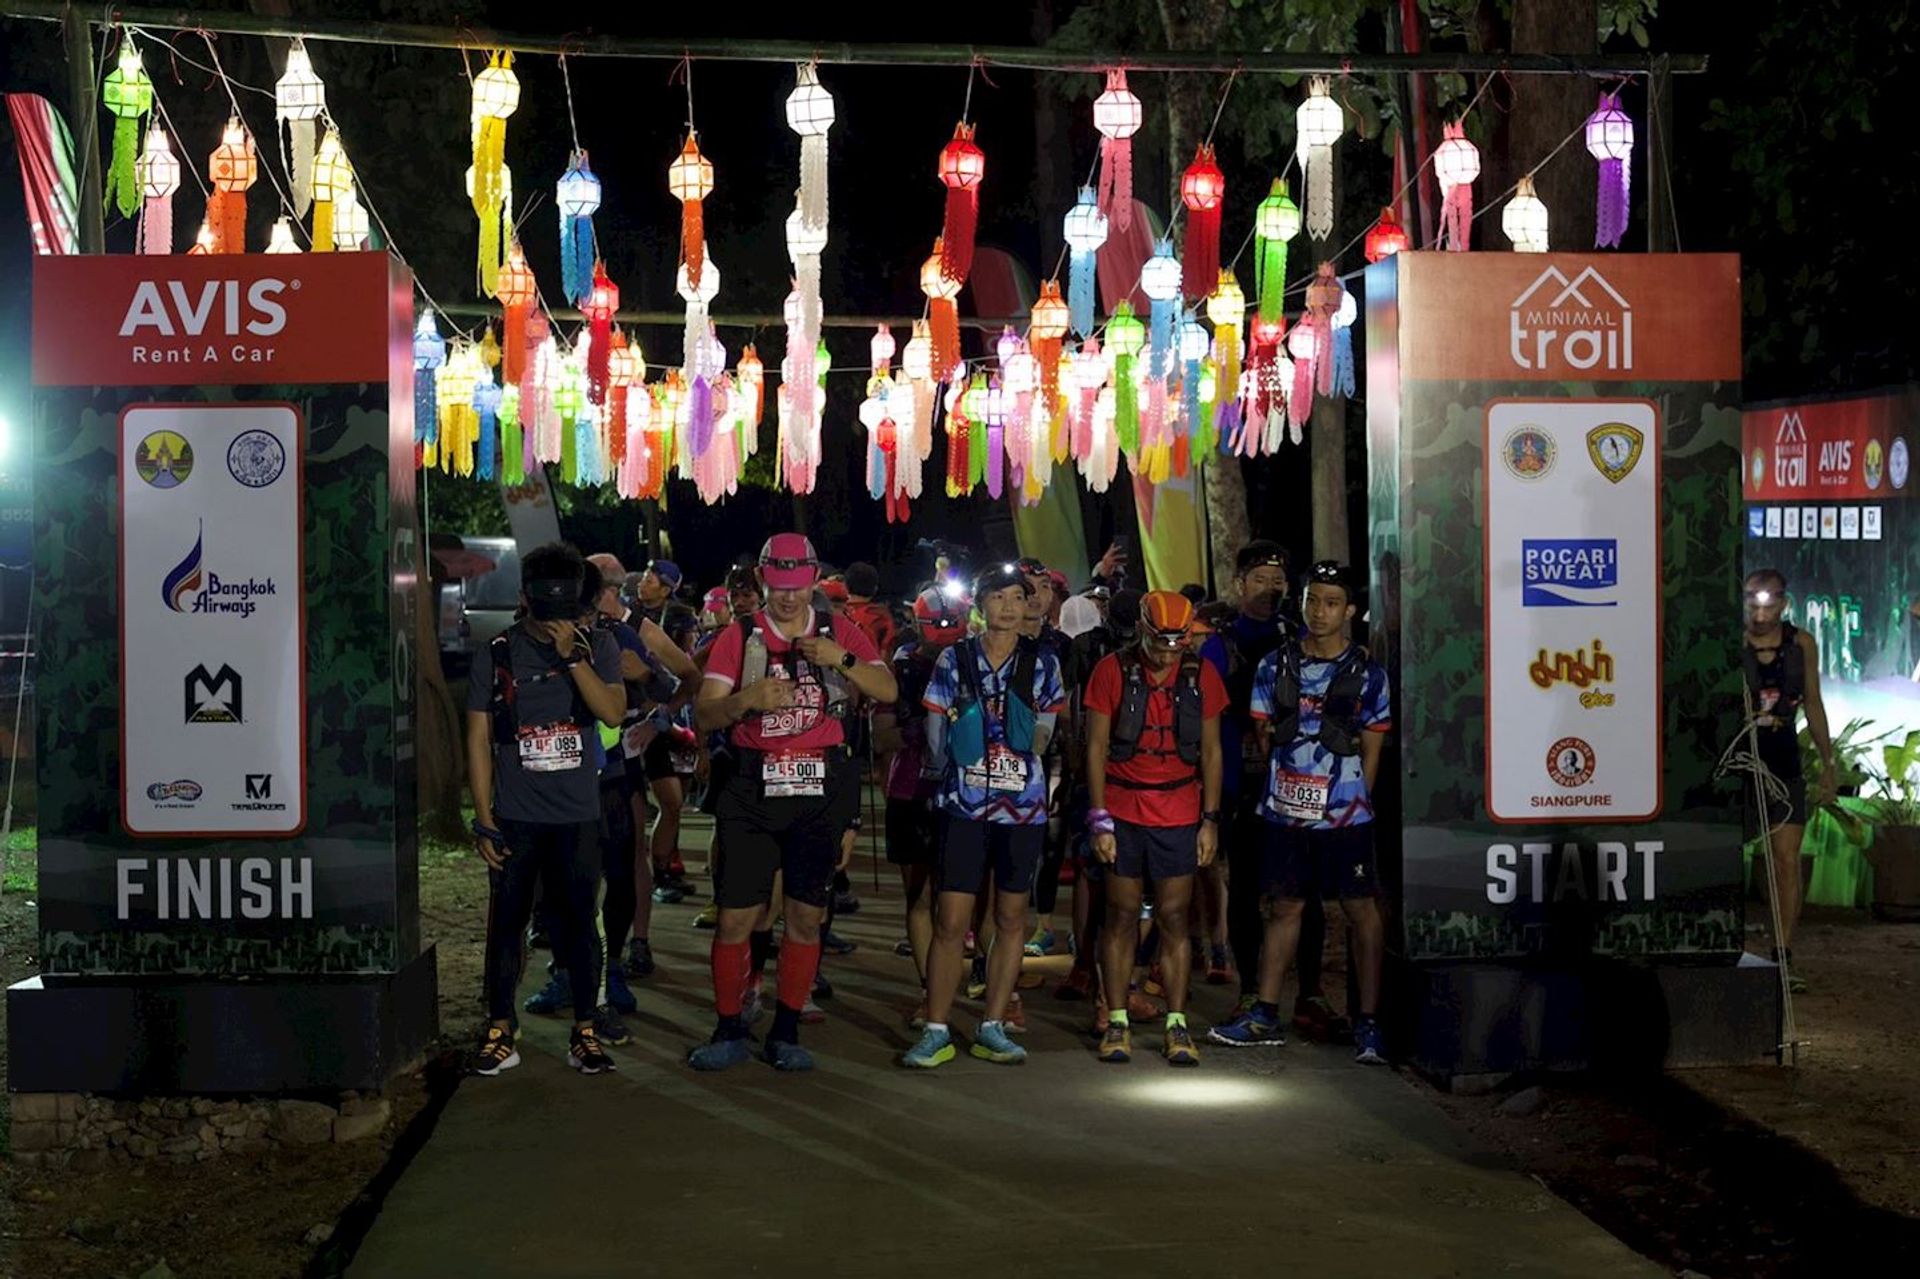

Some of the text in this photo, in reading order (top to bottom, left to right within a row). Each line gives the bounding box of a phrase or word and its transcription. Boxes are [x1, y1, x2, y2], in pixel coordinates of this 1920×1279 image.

[1526, 311, 1617, 325] MINIMAL
[133, 345, 275, 363] Rent A Car
[1511, 311, 1632, 369] trail
[1819, 440, 1851, 471] AVIS
[1526, 549, 1614, 564] POCARI
[209, 572, 276, 600] Bangkok
[1526, 565, 1606, 580] SWEAT
[192, 590, 256, 619] Airways
[761, 708, 819, 737] 2017
[1531, 795, 1612, 808] SIANGPURE
[1486, 841, 1664, 904] START
[117, 858, 313, 919] FINISH
